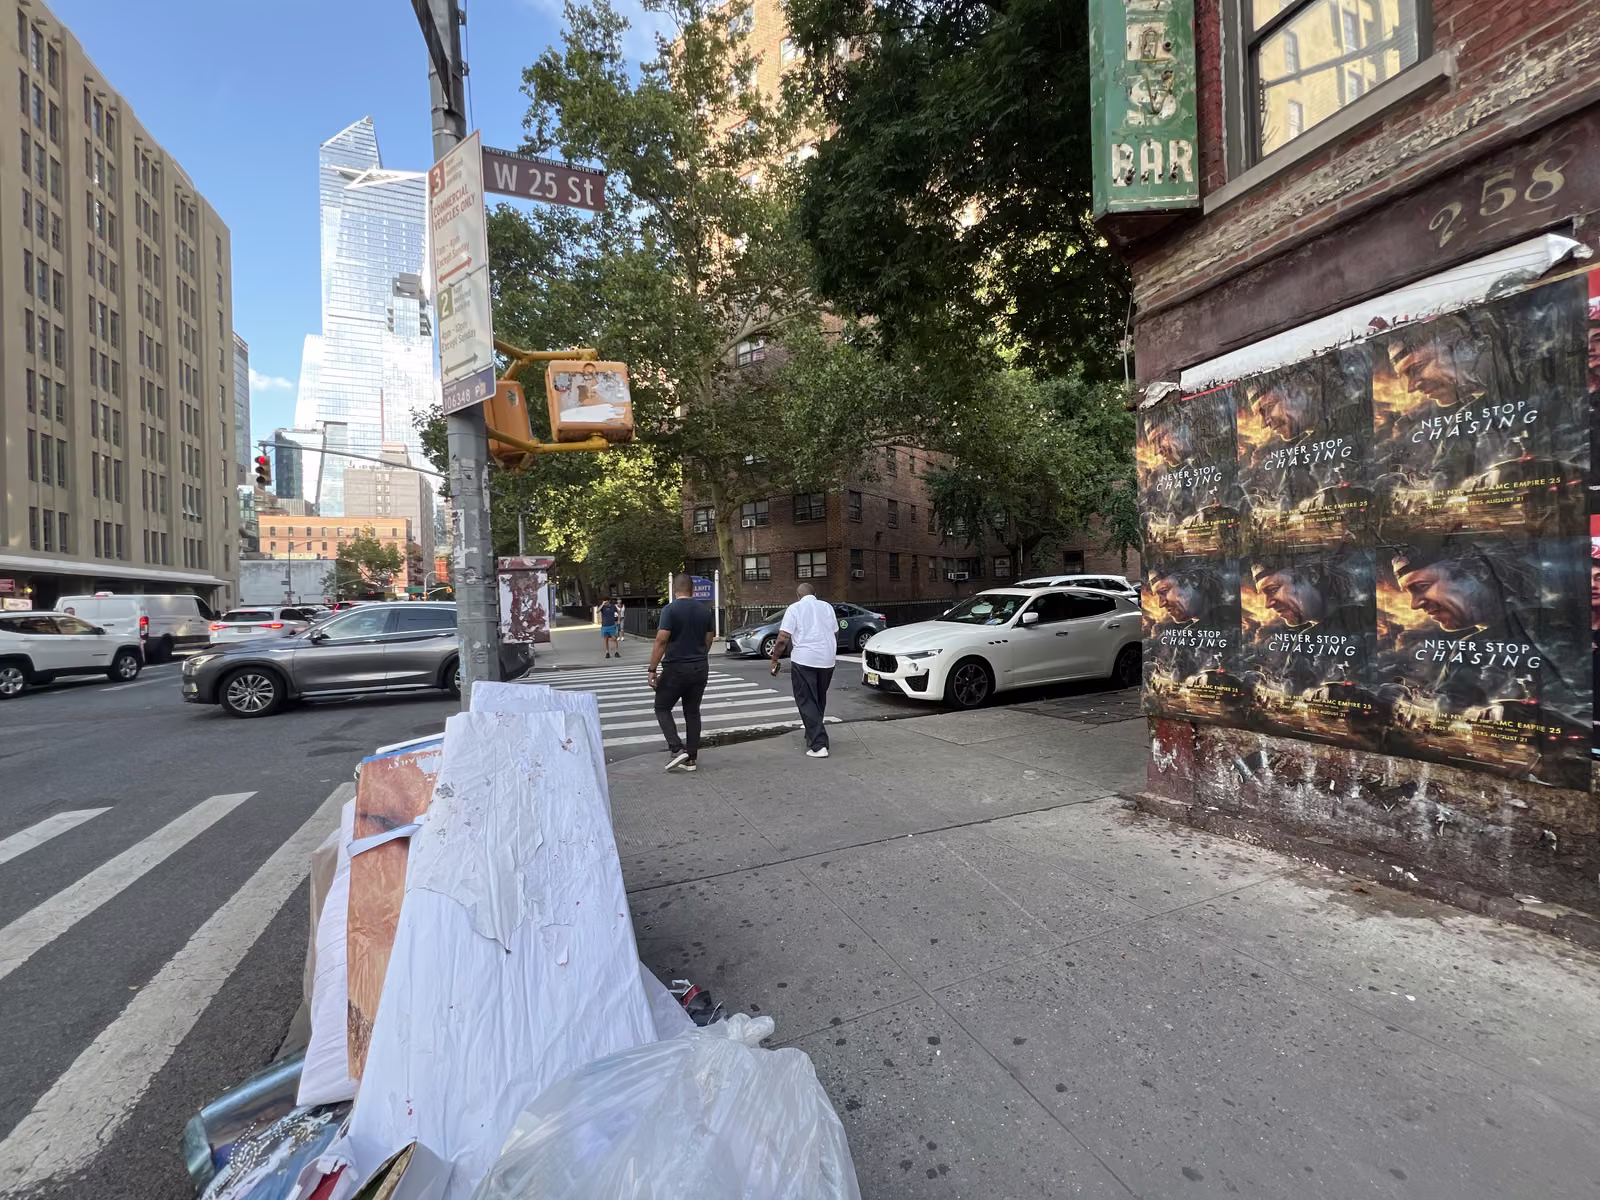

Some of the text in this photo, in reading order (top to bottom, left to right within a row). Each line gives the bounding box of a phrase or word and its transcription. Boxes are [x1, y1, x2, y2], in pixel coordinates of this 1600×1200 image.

[485, 147, 600, 175] WEST CHELSEA HISTORIC DISTRICT
[1112, 139, 1193, 187] BAR
[432, 168, 441, 193] 3
[493, 161, 518, 192] W
[528, 168, 558, 199] 25
[567, 176, 594, 206] St
[433, 184, 469, 218] COMMERCIAL
[1429, 144, 1579, 248] 258
[434, 191, 475, 231] VEHICLES ONLY
[441, 292, 450, 318] 2
[444, 388, 471, 411] 106348
[1421, 400, 1525, 430] NEVER STOP
[1411, 410, 1538, 443] CHASING
[1264, 446, 1352, 471] CHASING
[1270, 438, 1343, 459] NEVER STOP
[1156, 472, 1222, 492] CHASING
[1158, 465, 1216, 483] NEVER STOP
[1489, 482, 1510, 491] AMC
[1513, 478, 1545, 488] EMPIRE
[1549, 476, 1561, 484] 25
[1334, 501, 1358, 509] EMPIRE
[1485, 497, 1514, 505] AUGUST
[1160, 636, 1228, 648] CHASING
[1165, 629, 1221, 638] NEVER STOP
[1274, 633, 1347, 645] NEVER STOP
[1268, 641, 1356, 657] CHASING
[1424, 639, 1530, 654] NEVER STOP
[1415, 649, 1541, 669] CHASING
[1337, 701, 1361, 709] EMPIRE
[1490, 732, 1518, 742] AUGUST
[1492, 719, 1514, 728] AMC
[1549, 727, 1562, 735] 25
